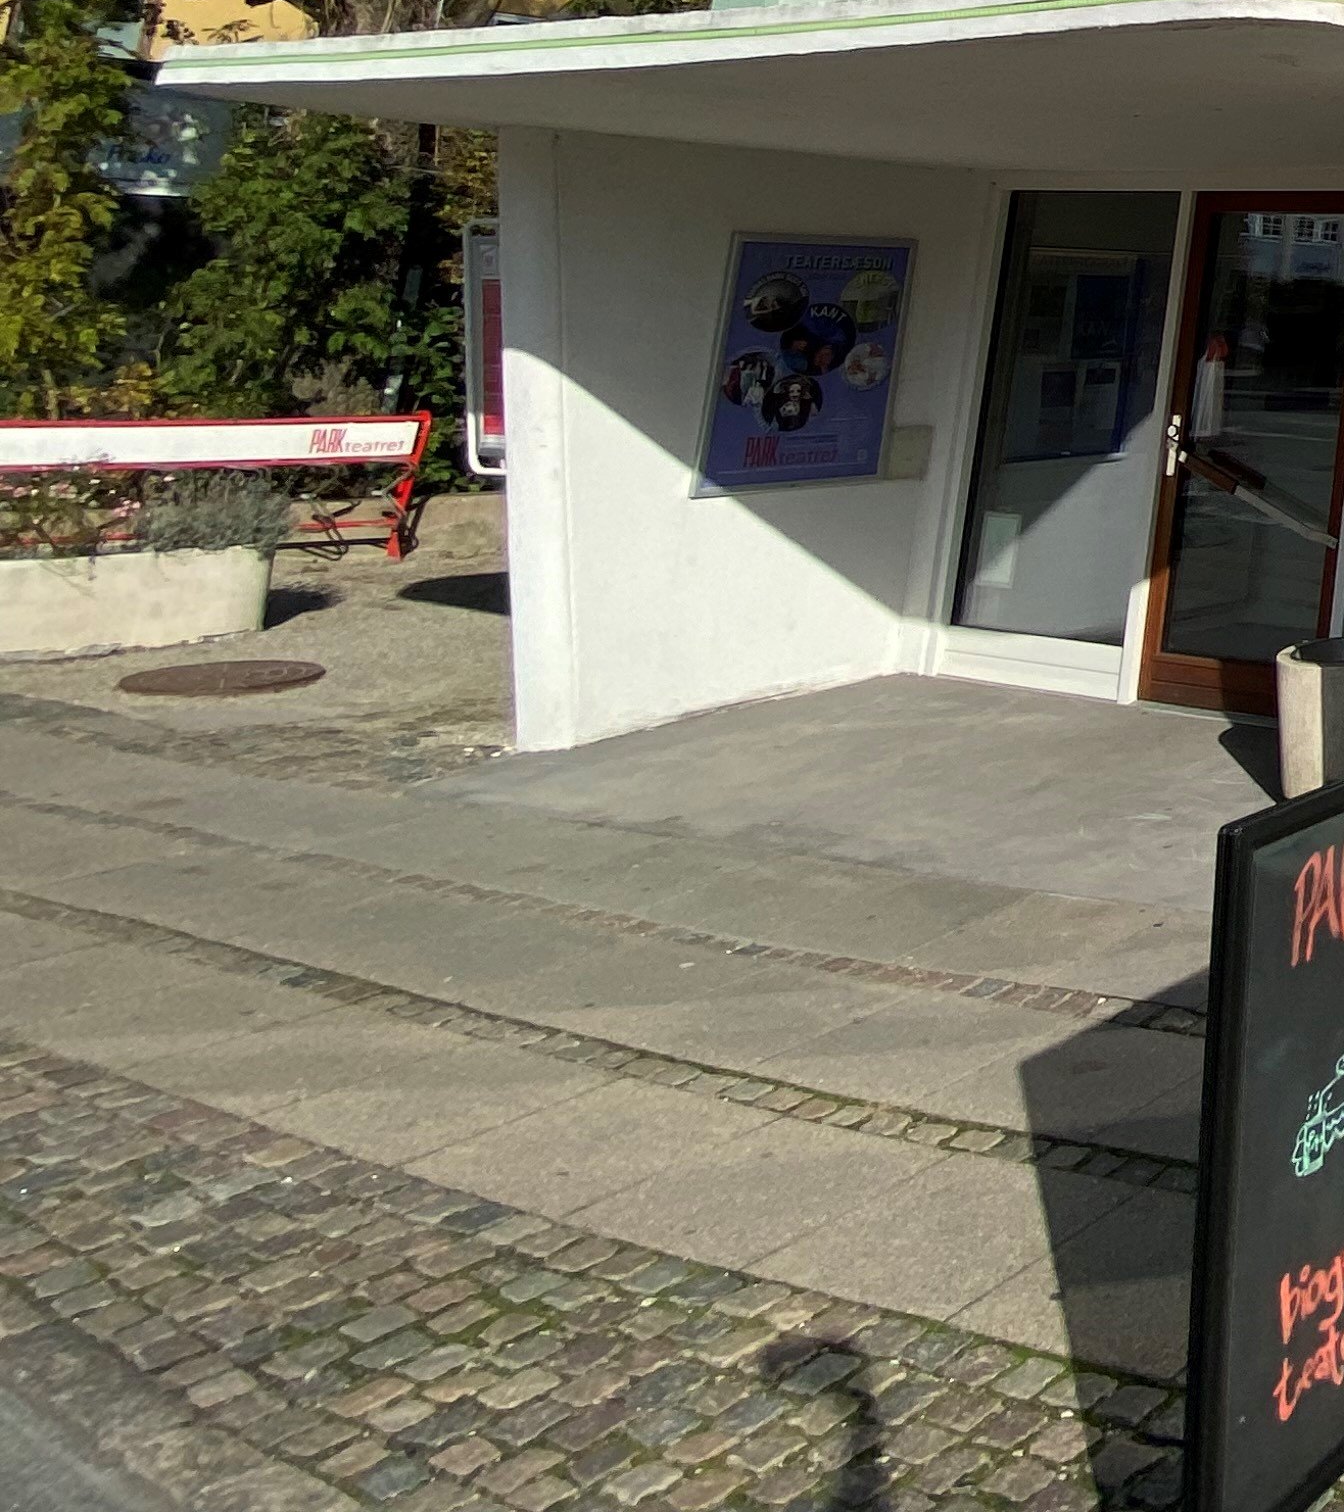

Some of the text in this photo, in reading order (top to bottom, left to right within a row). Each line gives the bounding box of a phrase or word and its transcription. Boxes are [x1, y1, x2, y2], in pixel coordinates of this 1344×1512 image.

[810, 305, 847, 323] KANT
[308, 429, 405, 454] PARK teatret
[743, 436, 780, 468] PARK
